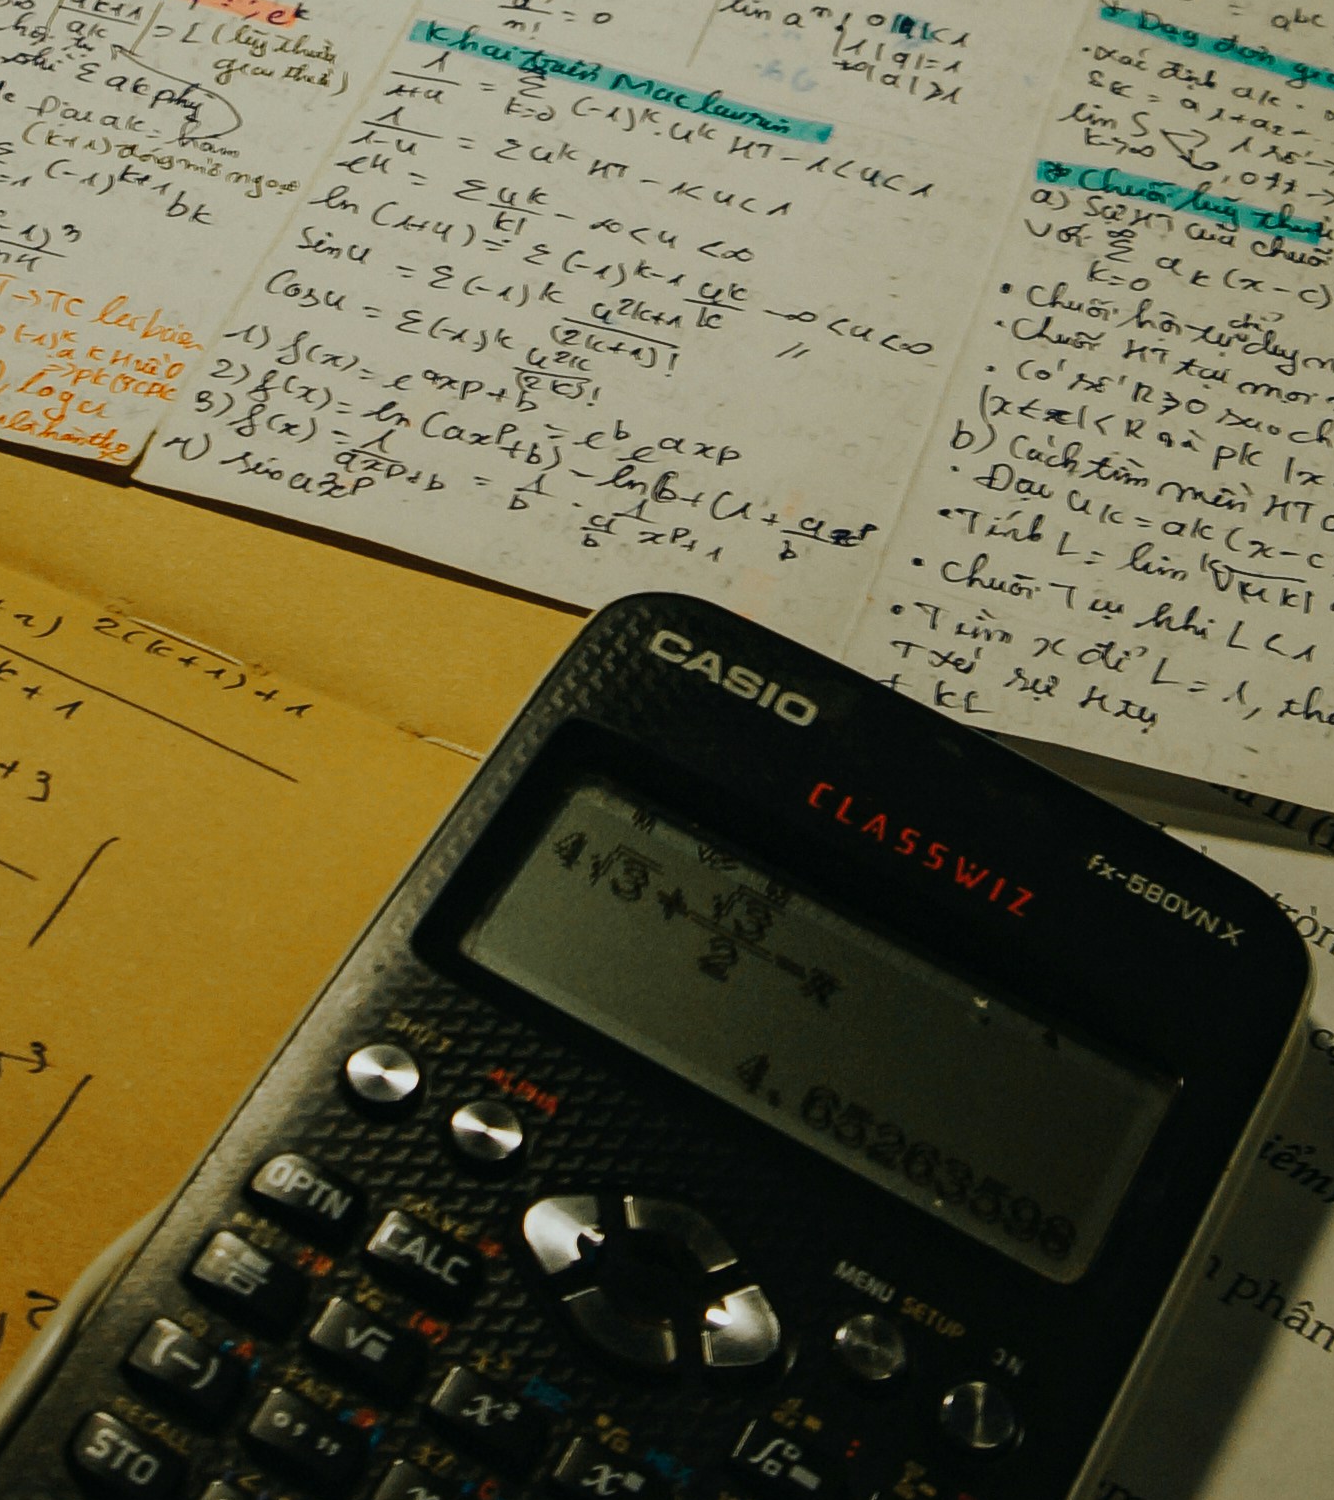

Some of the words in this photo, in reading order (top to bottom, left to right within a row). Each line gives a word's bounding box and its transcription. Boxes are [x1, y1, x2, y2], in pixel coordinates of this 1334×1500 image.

[647, 626, 822, 730] CASIO
[805, 780, 1039, 920] CLASSWIZ
[265, 1160, 355, 1222] OPTN
[371, 1223, 472, 1287] CALC
[832, 1256, 898, 1306] MENU
[898, 1295, 968, 1342] SETUP
[80, 1424, 161, 1490] STO
